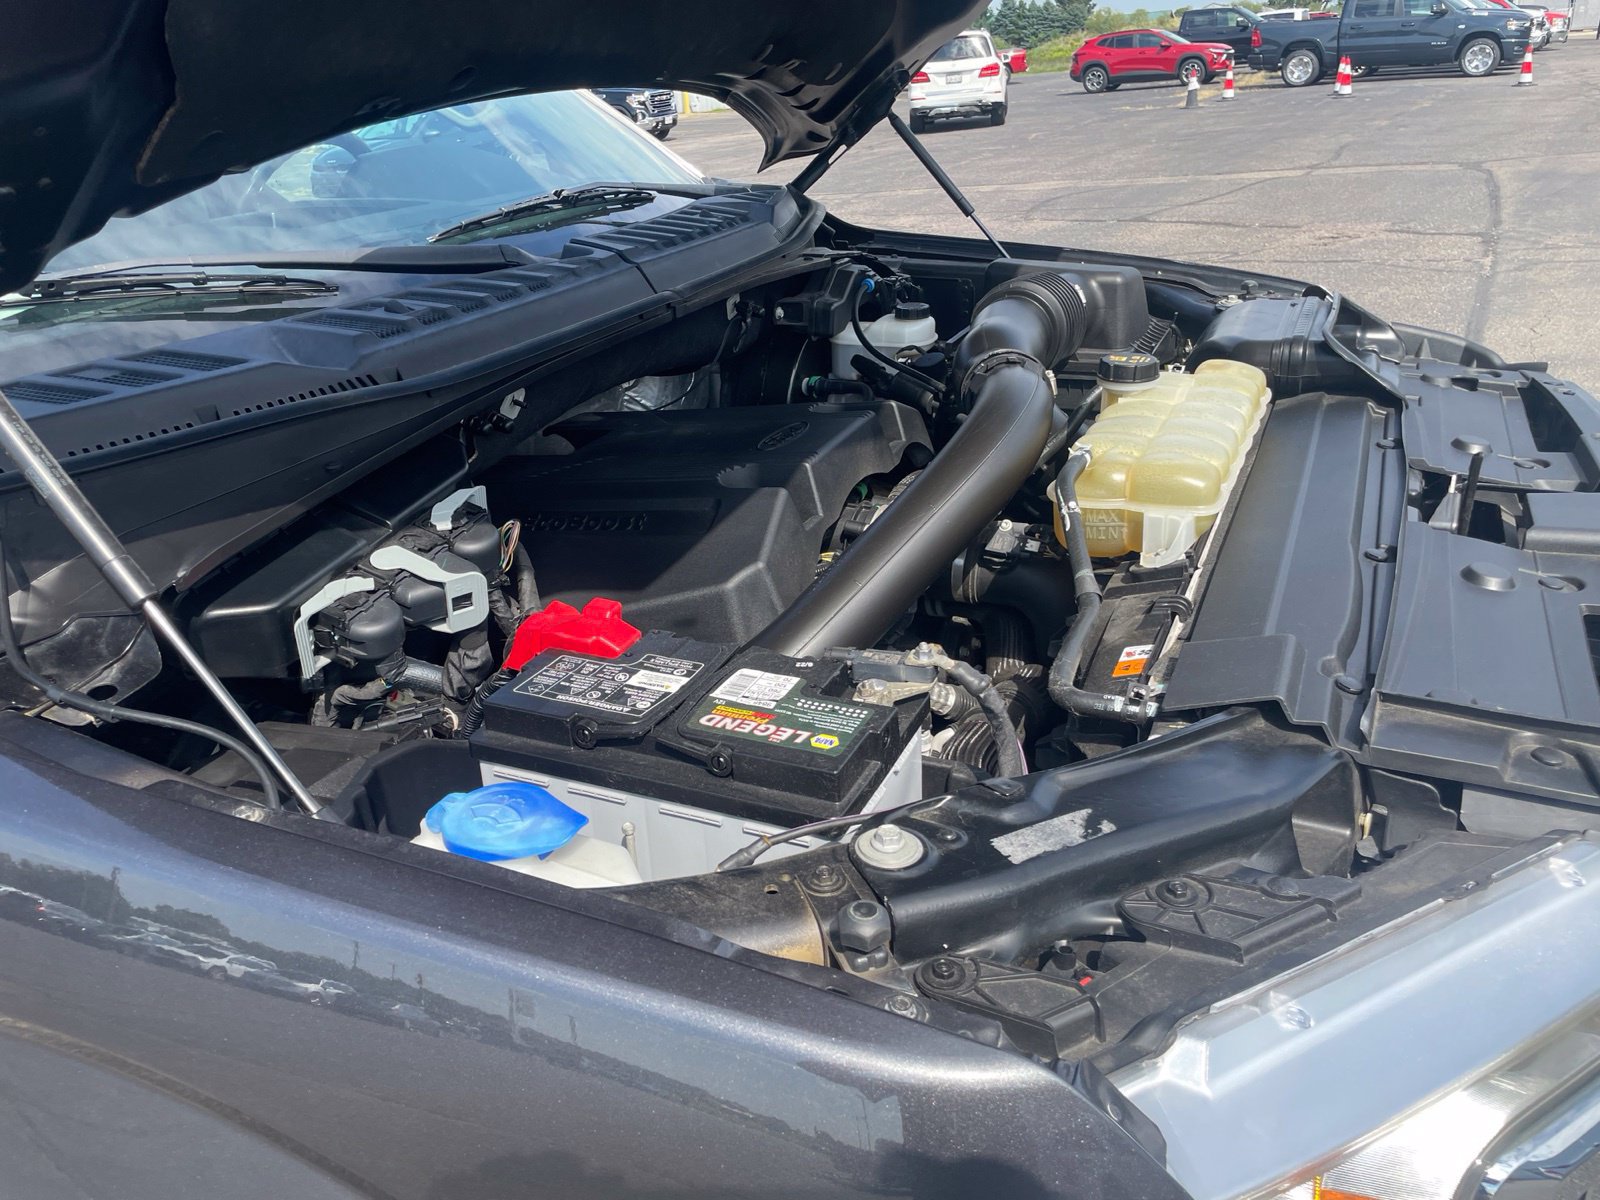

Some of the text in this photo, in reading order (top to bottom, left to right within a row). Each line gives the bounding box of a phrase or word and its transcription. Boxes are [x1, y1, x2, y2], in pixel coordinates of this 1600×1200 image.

[1086, 509, 1119, 523] MAX
[1086, 526, 1119, 539] MIN
[711, 708, 771, 724] Premium
[698, 713, 814, 744] LEGEND
[814, 736, 835, 746] NAPA
